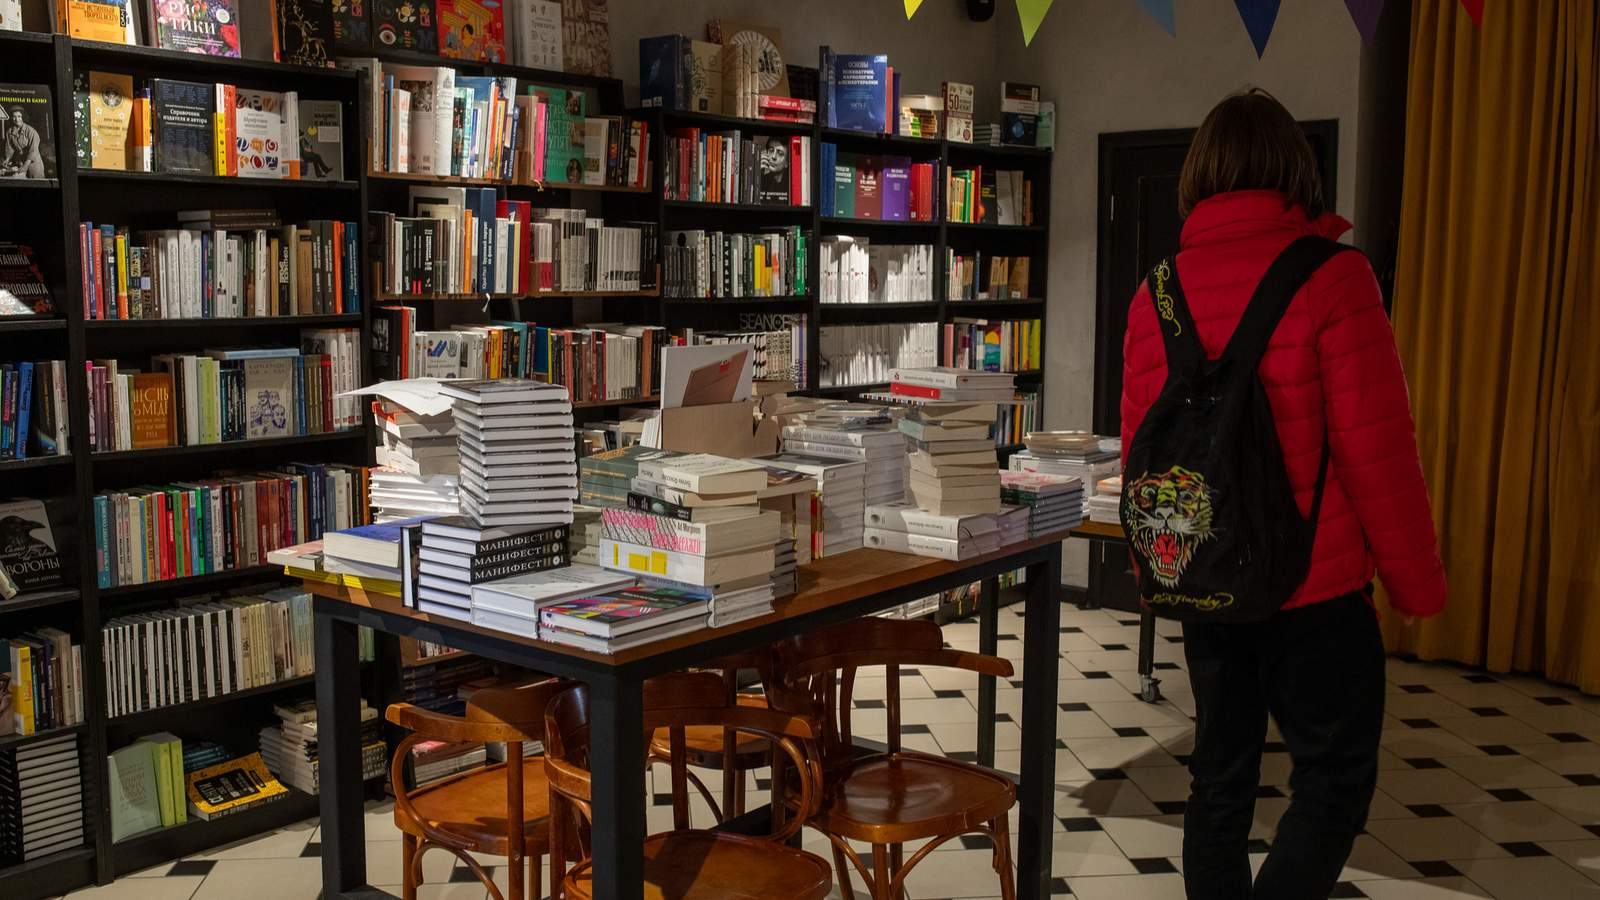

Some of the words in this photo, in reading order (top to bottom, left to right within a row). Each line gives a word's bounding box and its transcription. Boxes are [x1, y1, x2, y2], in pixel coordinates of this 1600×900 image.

[171, 17, 216, 34] ТИКИ
[948, 94, 960, 111] 50
[479, 532, 545, 553] МАНИФЕСТ
[6, 557, 61, 576] ВОРОНЫ
[474, 546, 542, 567] МАНИФЕСТ
[474, 559, 543, 580] МАНИФЕСТ
